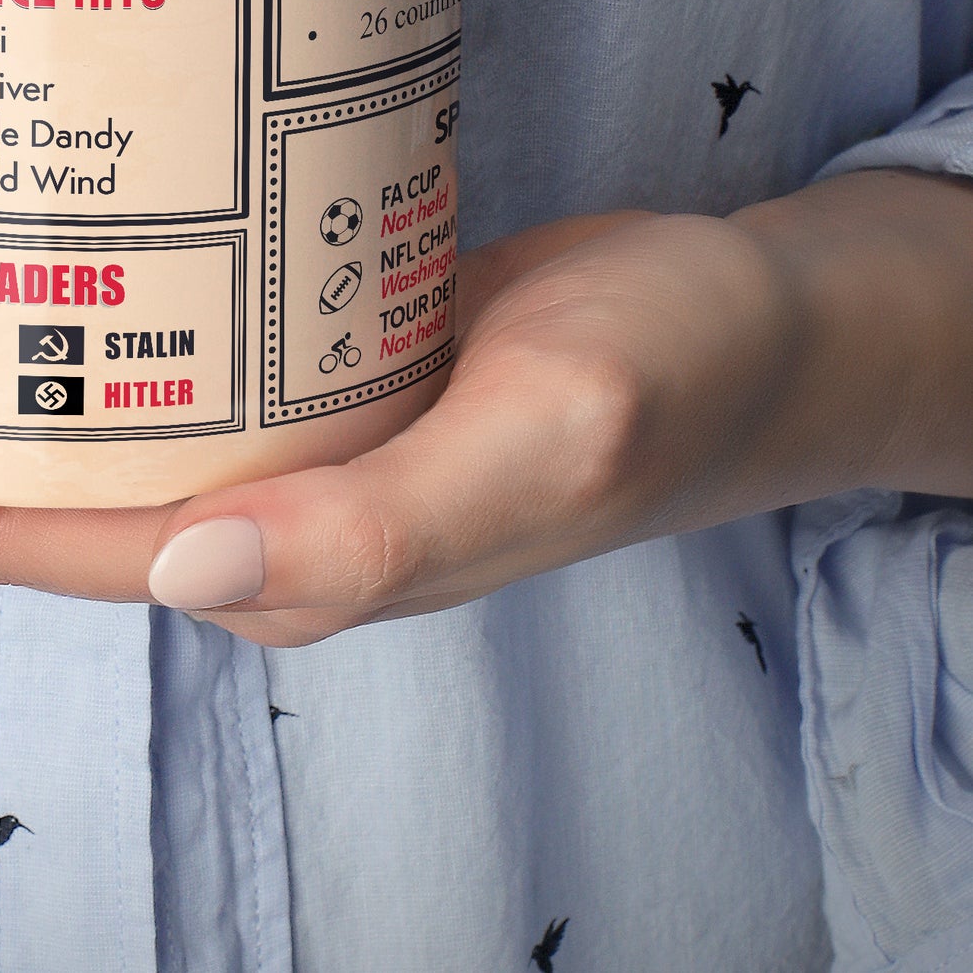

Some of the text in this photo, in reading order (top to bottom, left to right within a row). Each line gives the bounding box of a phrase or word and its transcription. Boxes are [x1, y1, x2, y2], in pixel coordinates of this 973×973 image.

[360, 7, 388, 40] 26
[30, 117, 134, 157] Dandy
[30, 163, 116, 195] Wind
[381, 164, 441, 210] FA CUP
[380, 182, 449, 238] Not held
[381, 241, 415, 273] NFL
[379, 293, 429, 333] TOUR
[432, 278, 450, 309] DE
[105, 329, 195, 360] STALIN
[379, 304, 447, 361] Not held
[104, 379, 194, 409] HITLER
